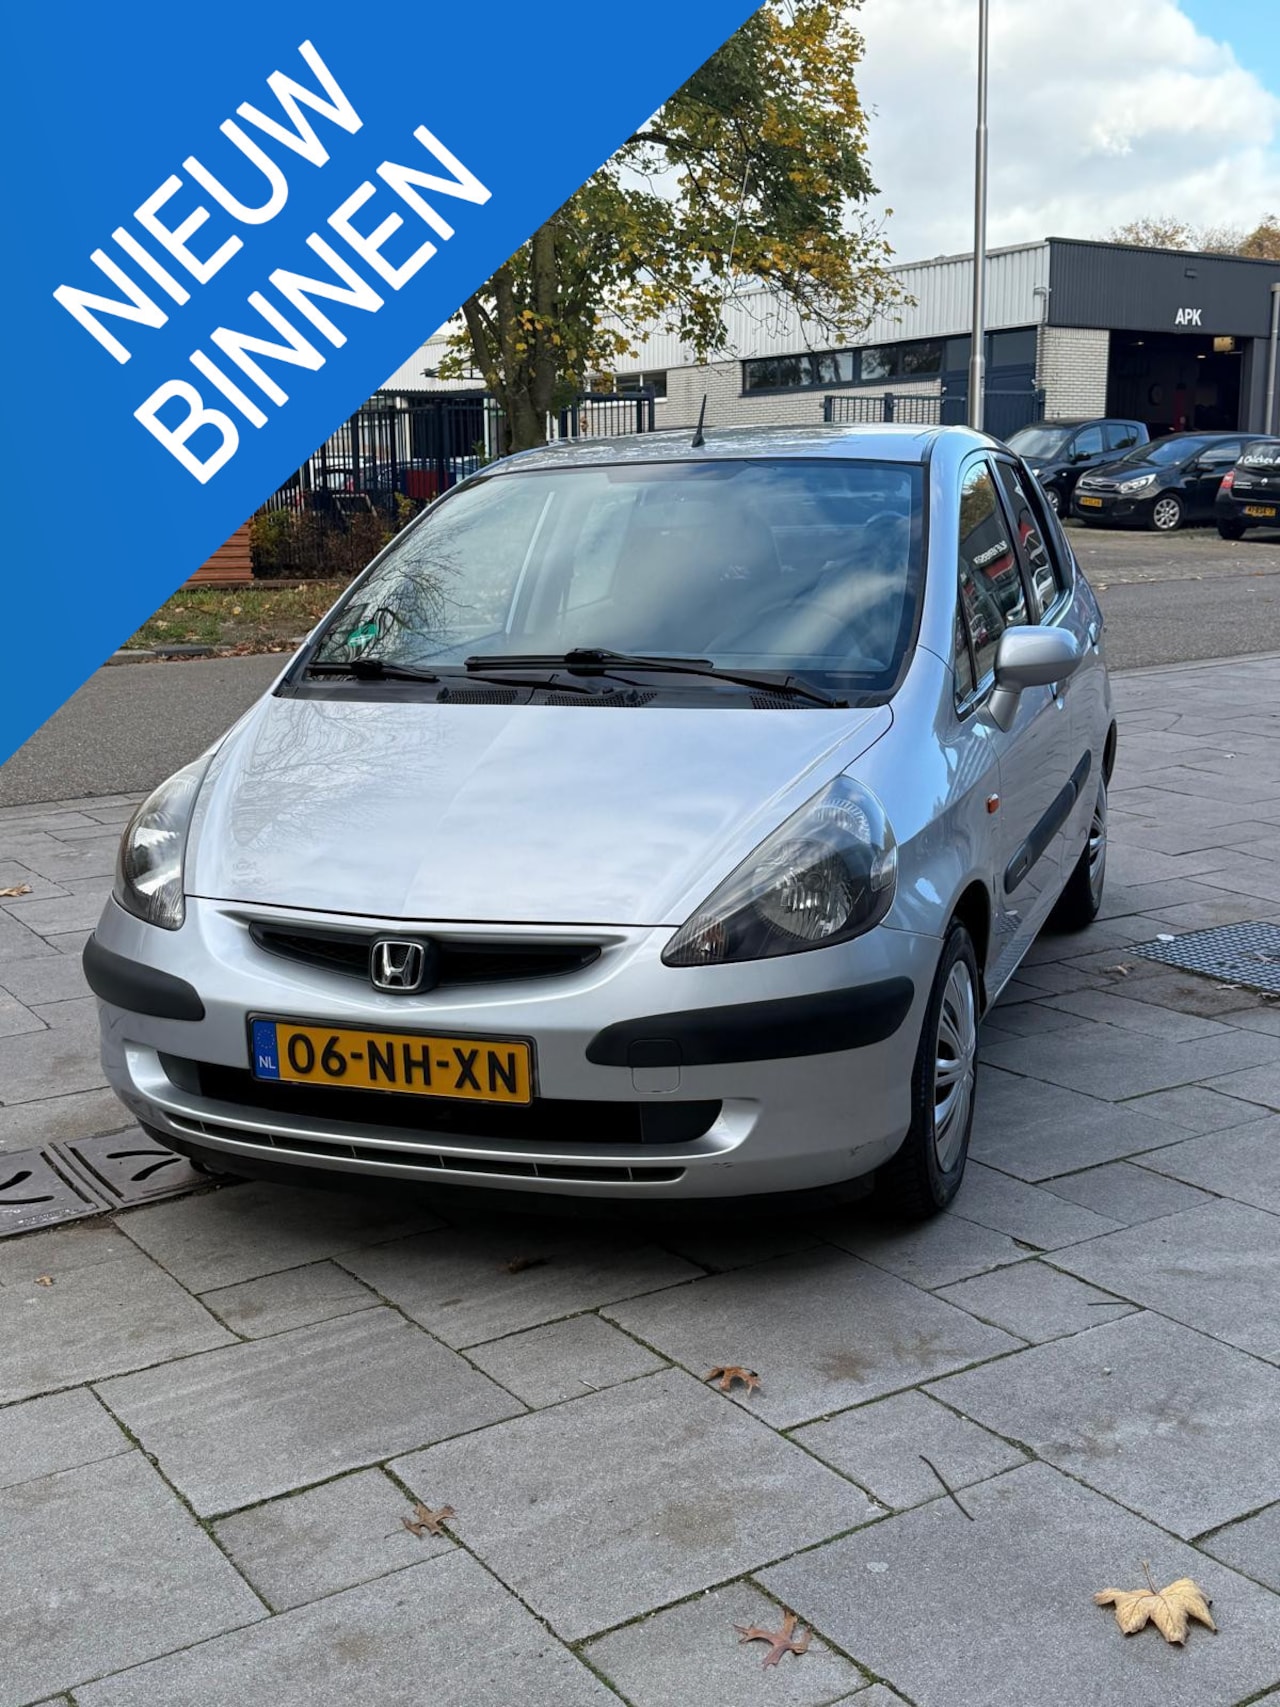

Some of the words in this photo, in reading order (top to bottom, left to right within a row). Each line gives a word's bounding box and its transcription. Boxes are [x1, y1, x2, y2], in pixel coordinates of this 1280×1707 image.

[1175, 307, 1202, 326] APK
[258, 1055, 276, 1070] NL
[287, 1033, 517, 1093] 06-NH-XN
